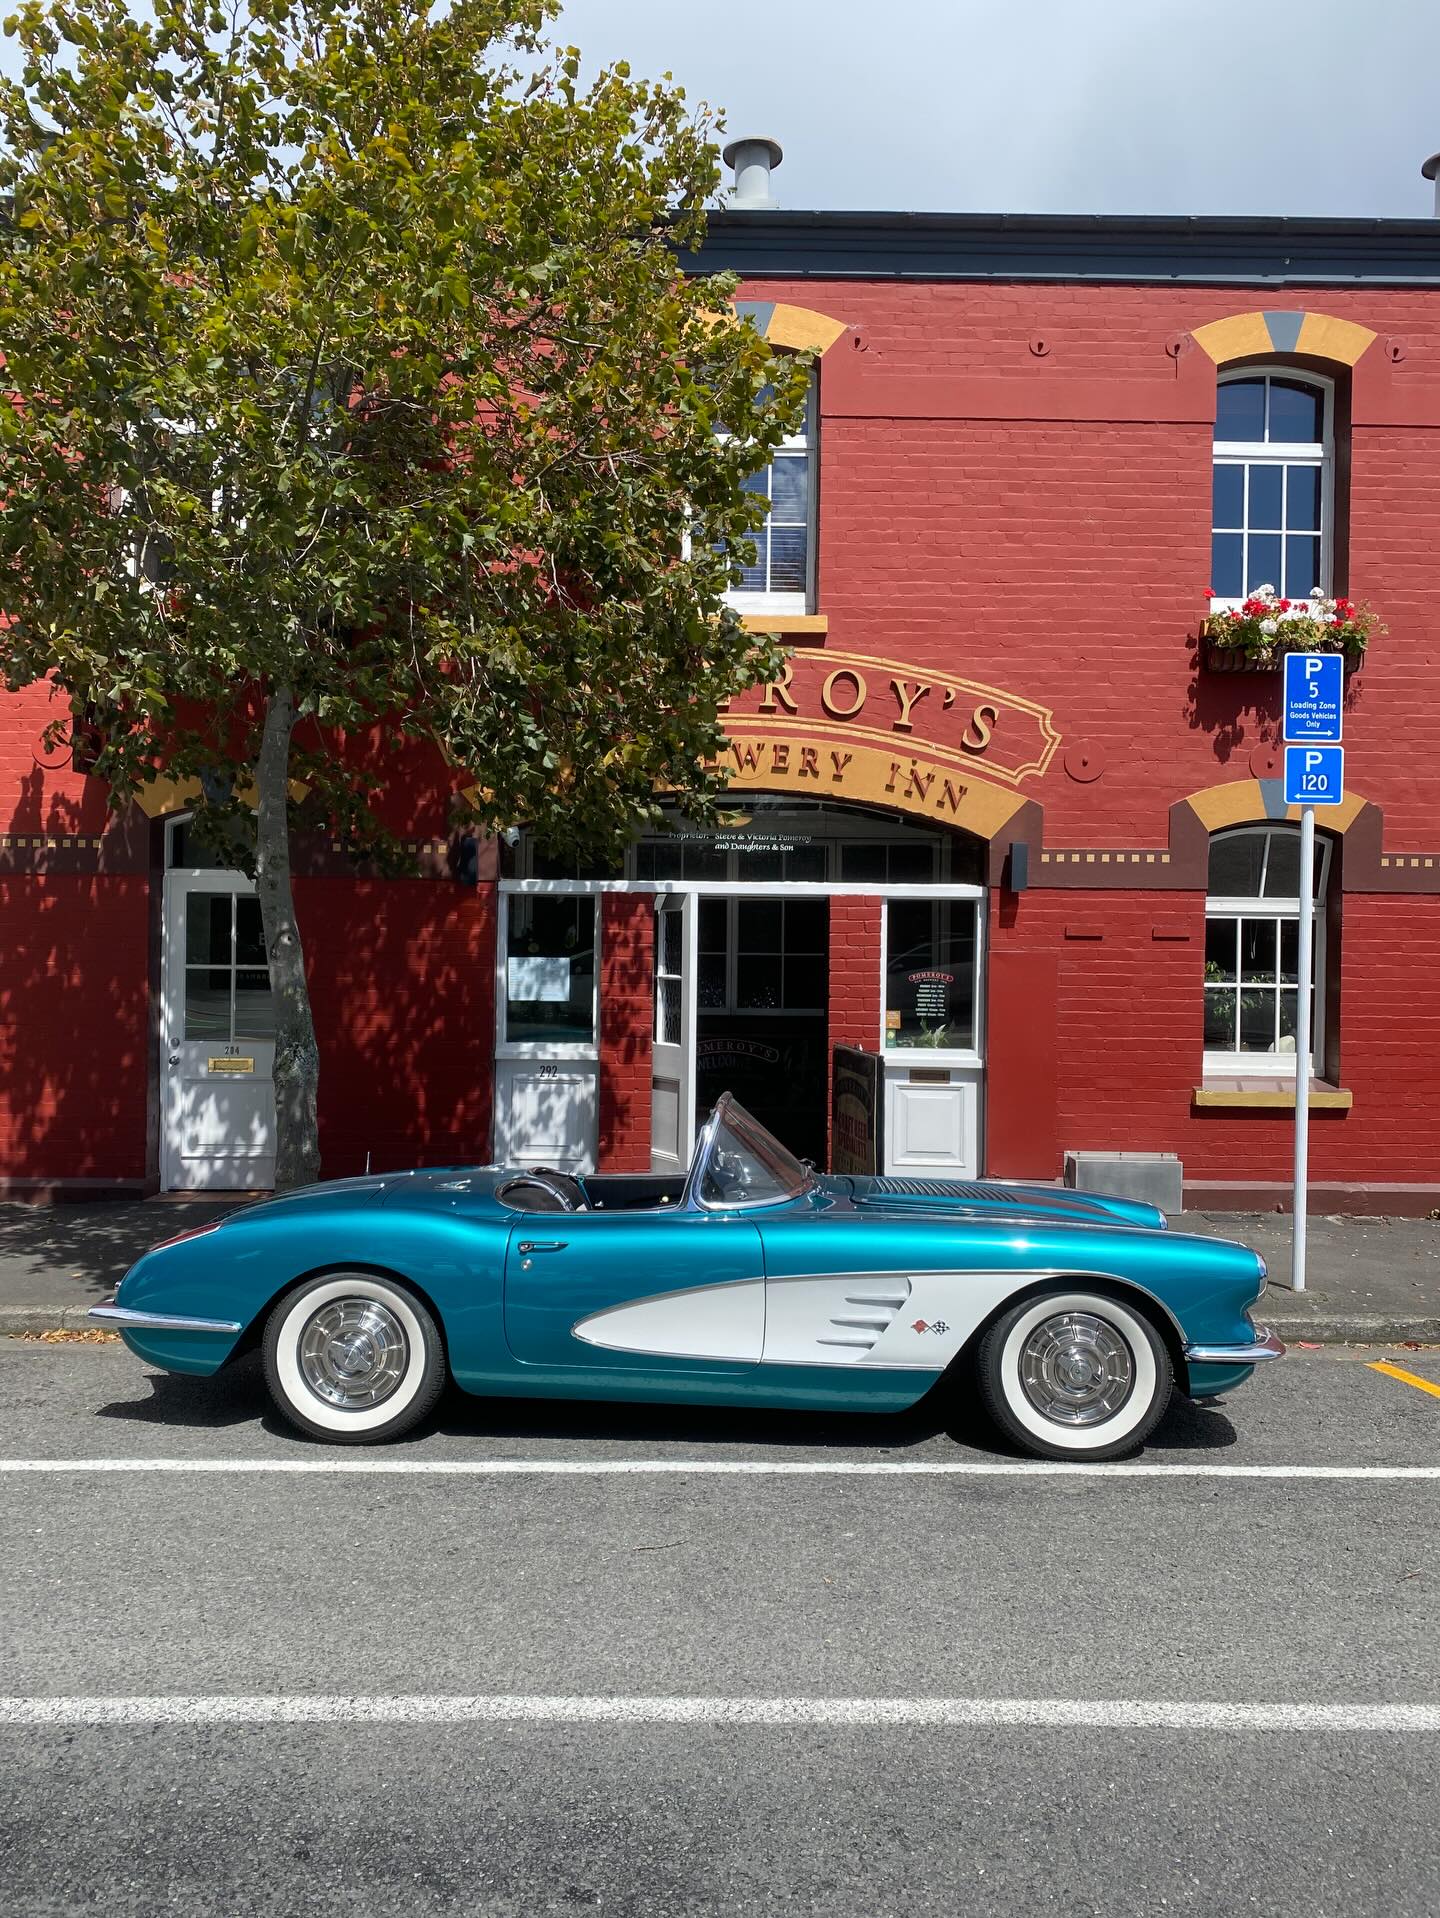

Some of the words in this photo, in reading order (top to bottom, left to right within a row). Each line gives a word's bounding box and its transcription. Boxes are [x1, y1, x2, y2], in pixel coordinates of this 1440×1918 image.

[1305, 658, 1323, 680] P
[1309, 682, 1319, 699] 5
[717, 664, 1000, 751] ROY'S
[1290, 701, 1317, 711] Loading
[1319, 702, 1336, 710] Zone
[1311, 712, 1337, 720] Vehicles
[1306, 720, 1321, 729] Only
[1305, 751, 1323, 772] P
[885, 762, 968, 814] INN
[1302, 775, 1328, 791] 120
[715, 832, 737, 841] Steve
[738, 833, 745, 841] &
[747, 833, 777, 841] Victoria
[779, 834, 812, 844] Pomeroy
[731, 841, 770, 852] Daughters
[539, 1065, 558, 1078] 292
